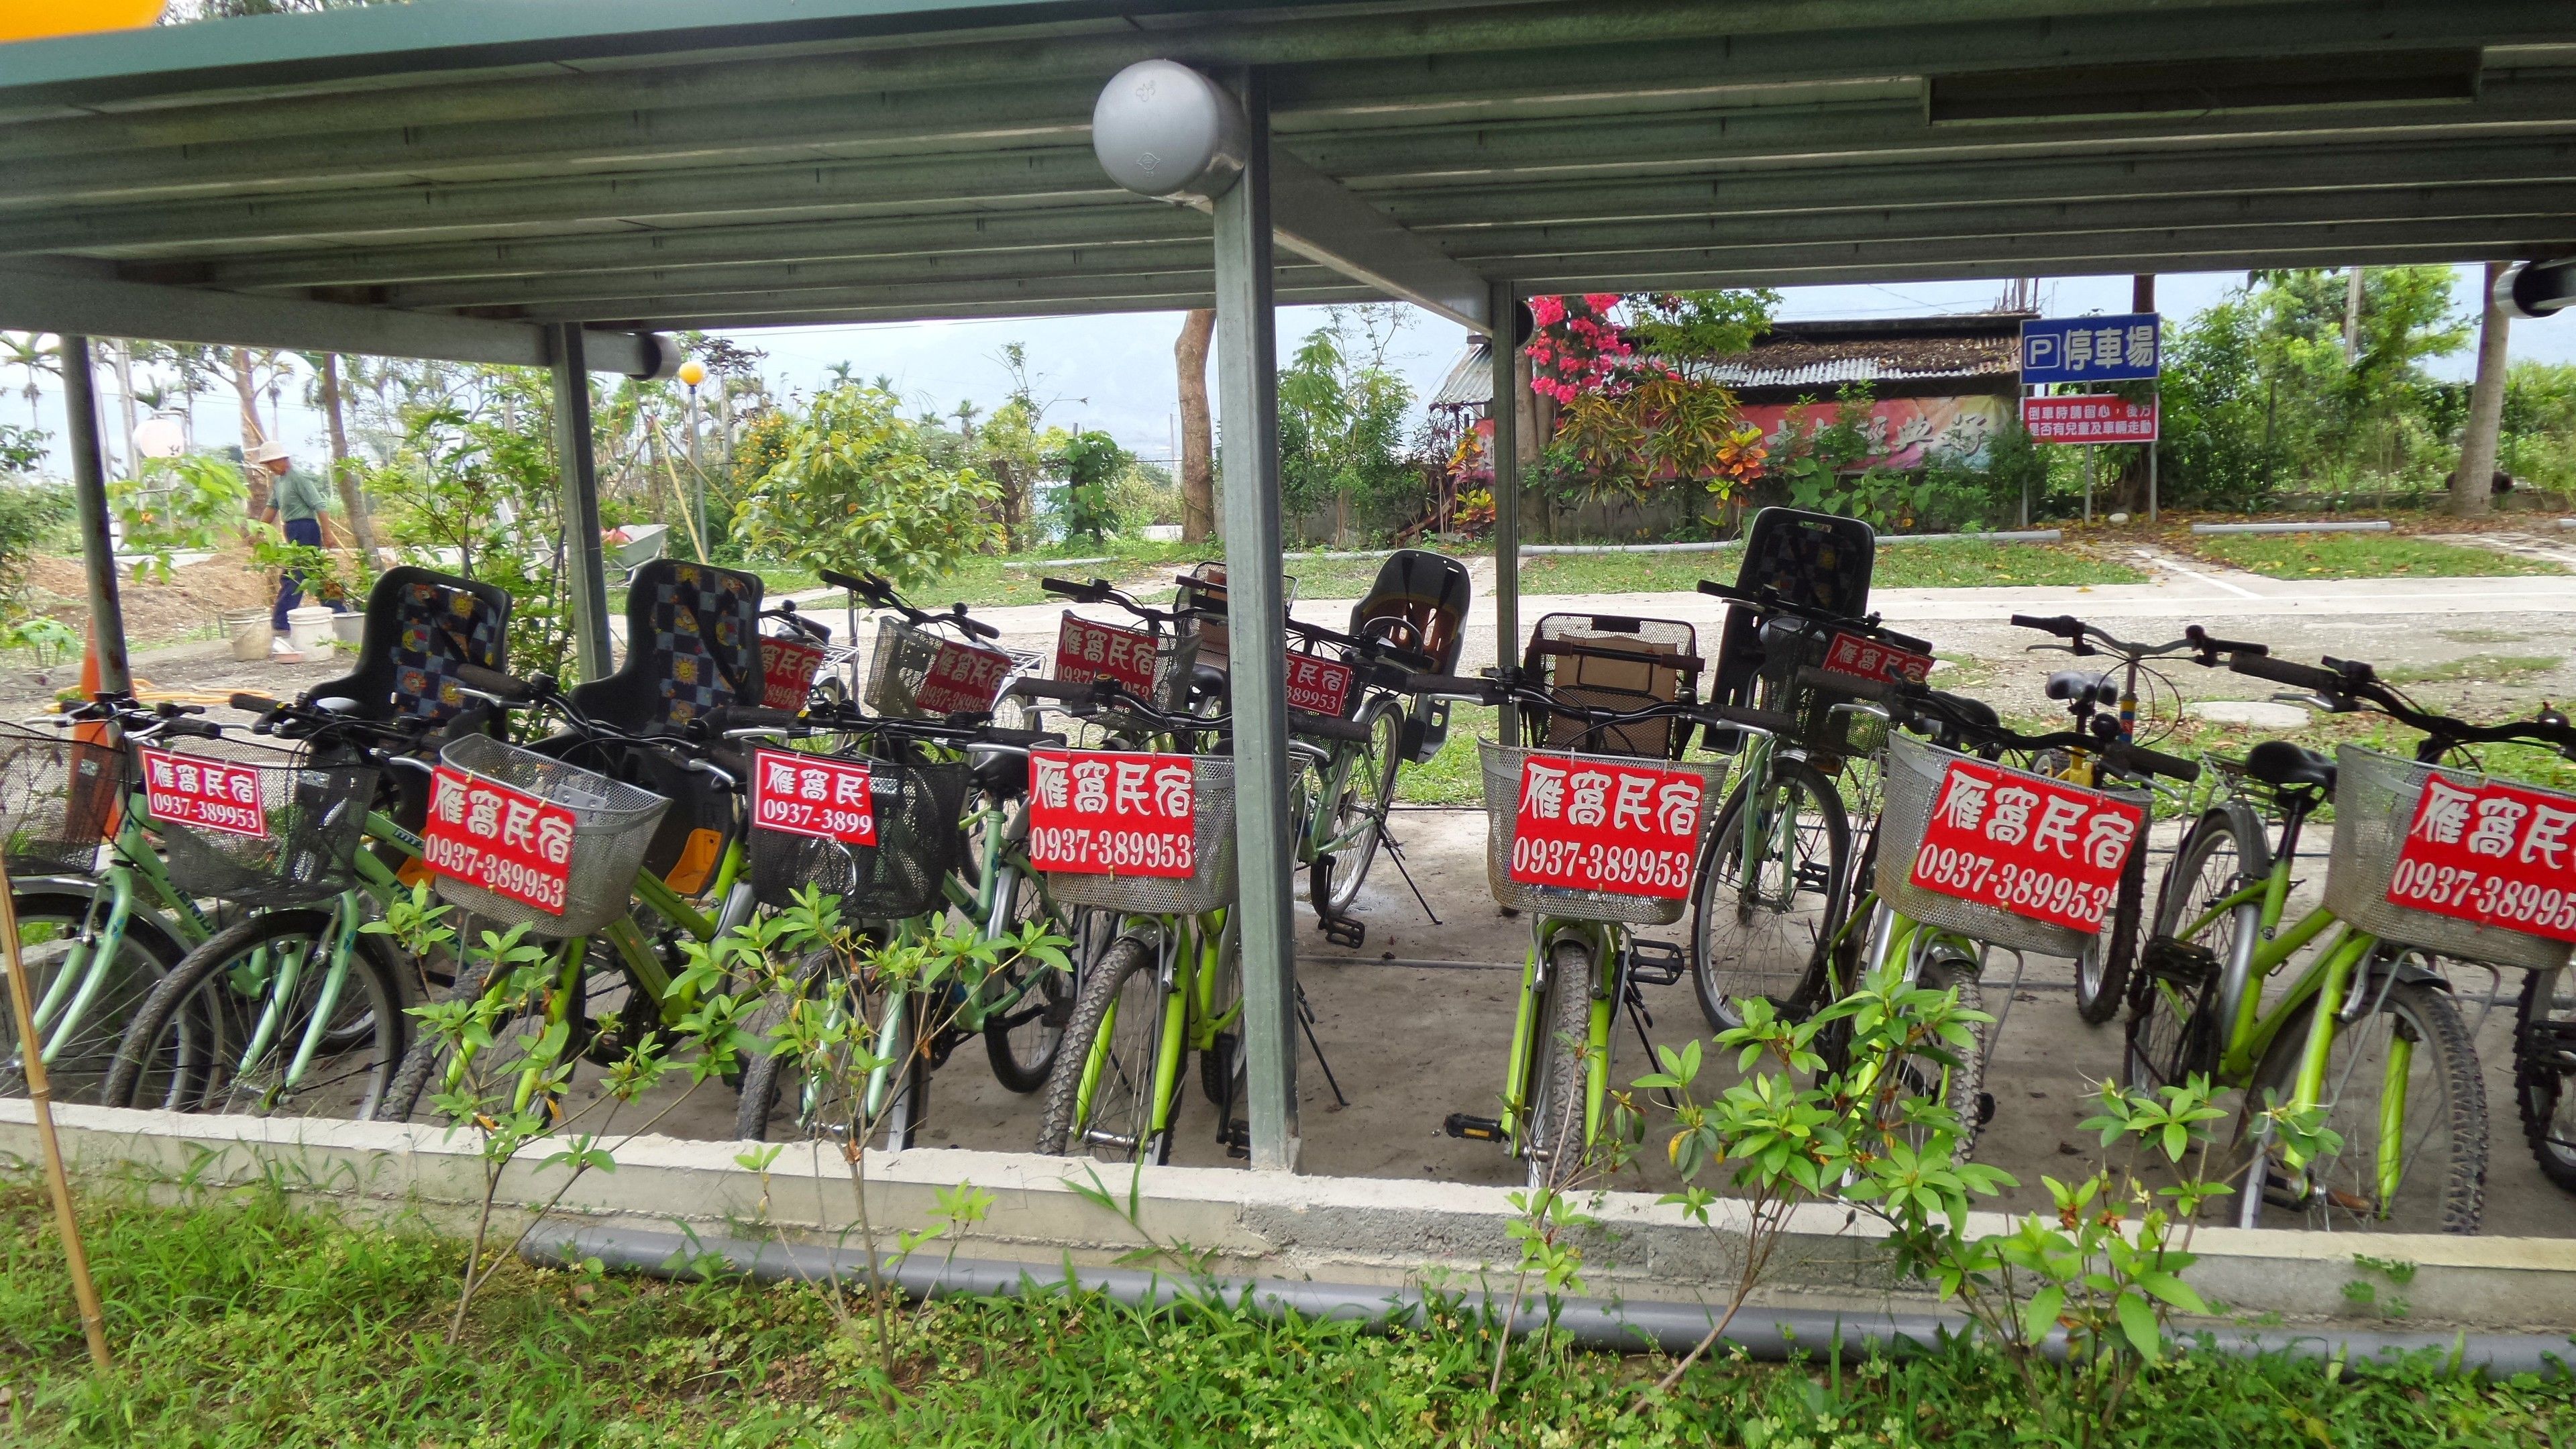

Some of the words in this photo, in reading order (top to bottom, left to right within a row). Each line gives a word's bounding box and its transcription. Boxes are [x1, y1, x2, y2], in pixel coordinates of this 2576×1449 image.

[2030, 339, 2052, 365] P
[2063, 325, 2155, 371] 停車場
[1059, 620, 1156, 676] 雁窩民宿
[150, 758, 254, 804] 雁窩民宿
[153, 792, 258, 829] 0937-389953
[765, 761, 864, 808] 雁窩民
[1031, 756, 1192, 818] 雁窩民宿
[1519, 762, 1701, 837] 雁窩民宿
[429, 773, 574, 864] 雁窩民宿
[763, 799, 872, 835] 0937-3899
[1933, 769, 2135, 869] 雁窩民宿
[2412, 782, 2576, 869] 雁窩民
[425, 833, 565, 908] 0937-389953
[1030, 826, 1191, 869] 0937-389953
[1513, 836, 1690, 888] 0937-389953
[1917, 843, 2110, 923] 0937-389953
[2393, 859, 2576, 930] 0937-38995
